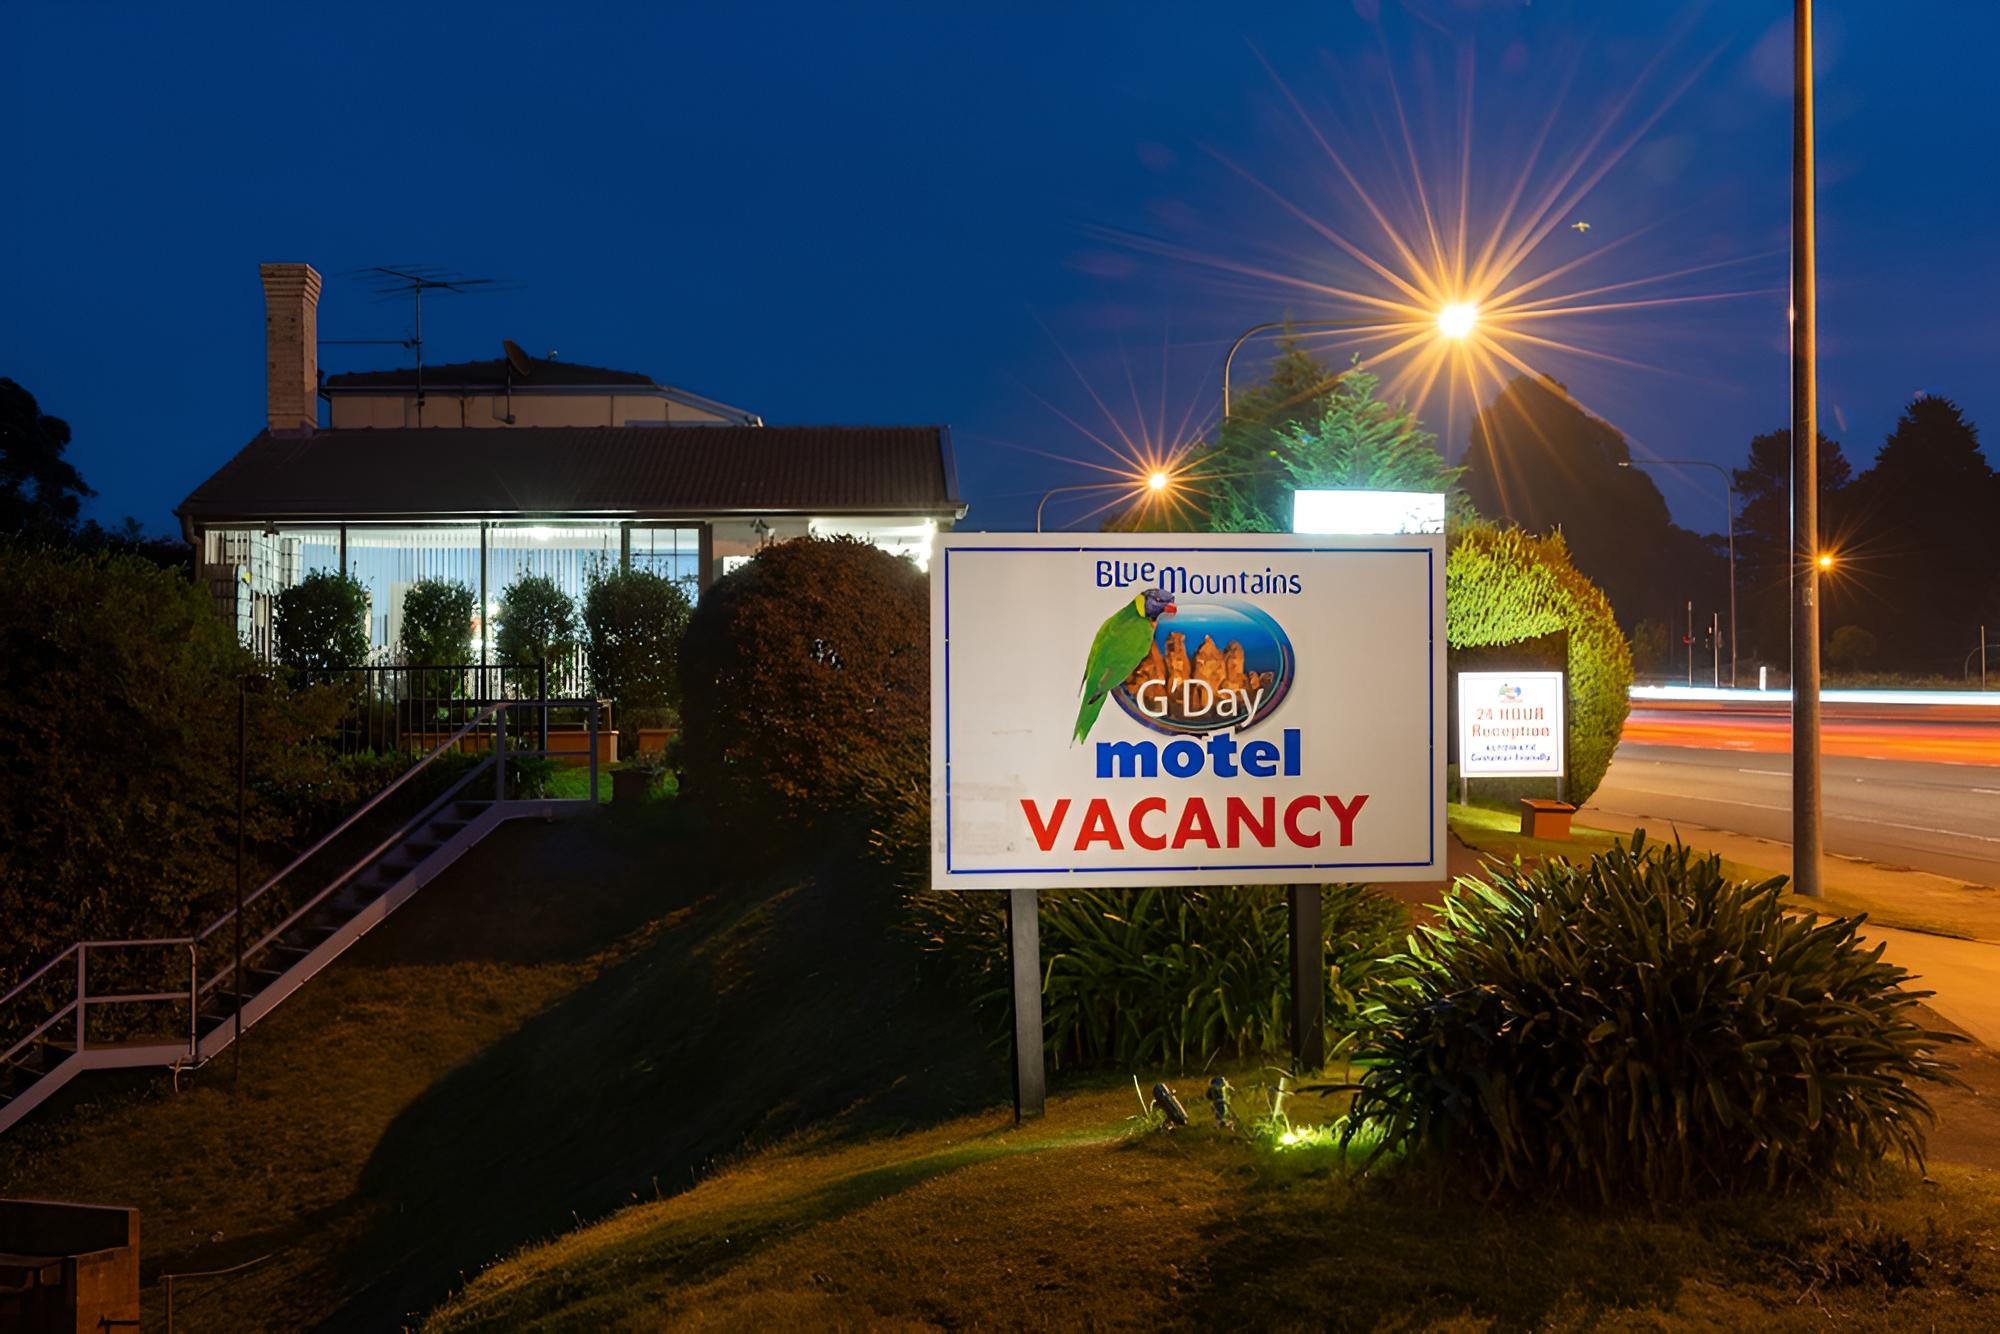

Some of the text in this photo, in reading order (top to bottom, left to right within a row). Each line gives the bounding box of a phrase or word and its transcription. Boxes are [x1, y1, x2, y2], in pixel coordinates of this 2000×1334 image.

[1136, 678, 1264, 727] G'Day
[1096, 728, 1301, 778] motel
[1021, 795, 1369, 851] VACANCY
